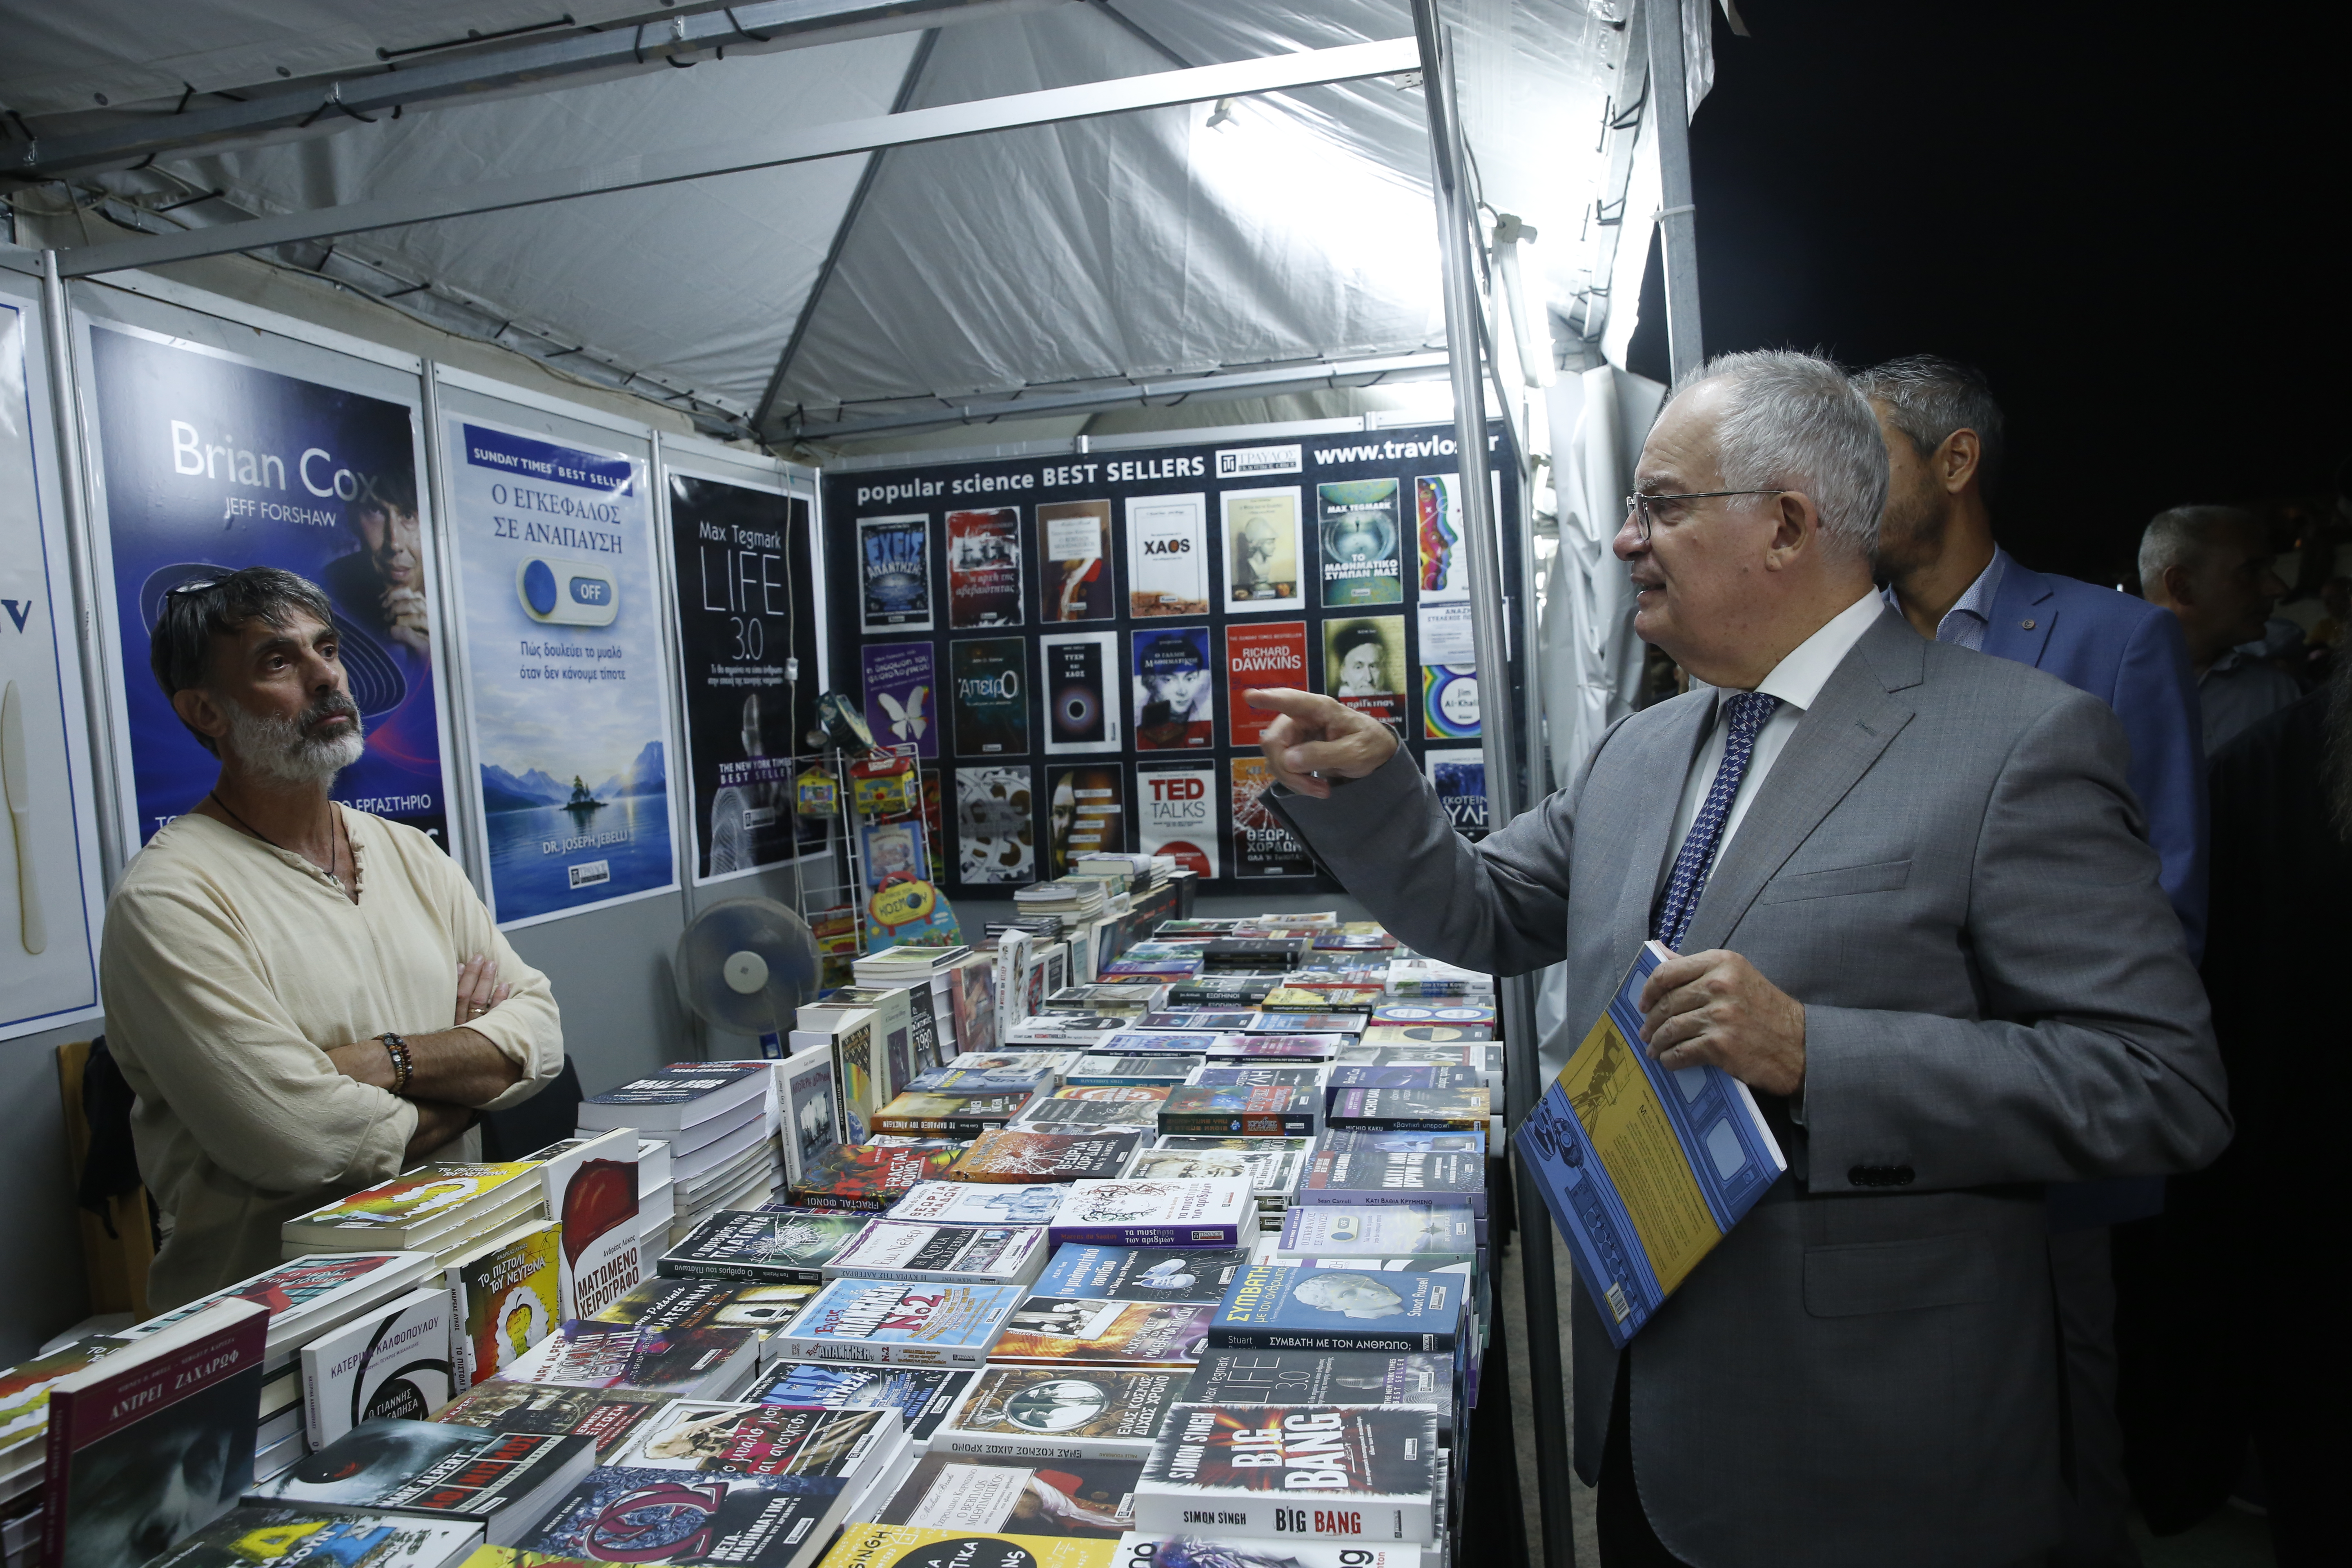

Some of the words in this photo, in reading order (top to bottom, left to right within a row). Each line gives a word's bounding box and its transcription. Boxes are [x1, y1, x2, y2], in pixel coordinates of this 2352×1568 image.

[171, 419, 286, 491] Brian
[300, 448, 378, 502] Cox
[473, 448, 518, 467] SUNDAY
[521, 458, 552, 474] TIMES
[558, 466, 586, 481] BEST
[1239, 449, 1296, 463] ΤΡΑΥΛΟΣ
[856, 475, 944, 506] popular
[952, 474, 1034, 495] science
[1042, 464, 1098, 487] BEST
[1107, 456, 1205, 482] SELLERS
[225, 496, 255, 519] JEFF
[261, 501, 337, 527] FORSHAW
[492, 483, 508, 505] Ο
[514, 488, 621, 524] ΕΓΚΕΦΑΛΟΣ
[1327, 505, 1347, 513] MAX
[1349, 501, 1392, 512] TEGMARK
[494, 516, 520, 539] ΣΕ
[524, 522, 623, 554] ΑΝΑΠΑΥΣΗ
[699, 521, 726, 542] Max
[731, 524, 782, 550] Tegmark
[1325, 559, 1398, 572] ΜΑΘΗΜΑΤΙΚΟ
[1325, 570, 1370, 580] ΣΥΜΠΑΝ
[1373, 567, 1398, 577] ΜΑΣ
[580, 584, 601, 600] OFF
[701, 546, 784, 615] LIFE
[521, 641, 541, 659] Πώς
[544, 643, 583, 657] δουλεύει
[585, 644, 595, 656] το
[597, 642, 622, 659] μυαλό
[730, 617, 764, 661] 3.0
[1242, 645, 1290, 658] RICHARD
[520, 666, 541, 679] όταν
[544, 667, 561, 680] δεν
[562, 667, 598, 683] κάνουμε
[599, 667, 626, 683] τίποτε
[1232, 655, 1302, 672] DAWKINS
[1458, 688, 1471, 698] Jim
[719, 762, 734, 773] THE
[735, 761, 752, 771] NEW
[720, 771, 749, 785] BEST
[1149, 778, 1205, 801] TED
[356, 794, 431, 813] ΕΡΓΑΣΤΗΡΙΟ
[1150, 801, 1205, 819] TALKS
[543, 841, 560, 855] DR.
[561, 837, 596, 855] JOSEPH
[597, 830, 628, 849] JEBELLI
[915, 1029, 933, 1052] 1980
[1363, 1098, 1378, 1117] MICHIO
[909, 1120, 919, 1129] ΤΟΥ
[920, 1120, 947, 1129] ΠΑΡΑΔΟΞΟ
[948, 1121, 956, 1129] ΤΟ
[1056, 1142, 1090, 1170] ΘΕΩΡΙΑ
[1071, 1140, 1106, 1171] ΧΟΡΔΩΝ
[884, 1150, 909, 1188] FRACTAL
[900, 1159, 921, 1187] ΦΟΝΟΙ
[807, 1197, 837, 1207] ΦΟΝΟΙ
[840, 1198, 879, 1209] FRACTAL
[909, 1186, 948, 1216] ΘΕΩΡΙΑ
[922, 1186, 962, 1217] ΟΜΑΔΩΝ
[1302, 1212, 1316, 1241] ΕΓΚΕΦΑΛΟΣ
[1317, 1212, 1329, 1238] ΑΝΑΠΑΥΣΗ
[497, 1249, 514, 1261] ΑΝΔΡΕΑΣ
[514, 1243, 528, 1254] ΛΥΚΟΣ
[603, 1246, 622, 1258] Ανδρέας
[622, 1235, 636, 1250] Λύκος
[941, 1228, 972, 1256] ΑΛΓΕΒΡΑΣ
[477, 1272, 491, 1288] ΤΟ
[492, 1253, 525, 1278] ΠΙΣΤΟΛΙ
[490, 1277, 506, 1294] ΤΟΥ
[506, 1256, 546, 1287] ΝΕΥΤΩΝΑ
[577, 1246, 638, 1300] ΜΑΤΩΜΕΝΟ
[674, 1264, 704, 1274] Πλάτωνα
[717, 1267, 746, 1276] αριθμός
[1064, 1247, 1100, 1288] μαθηματικό
[579, 1266, 640, 1321] ΧΕΙΡΟΓΡΑΦΟ
[1225, 1266, 1273, 1322] ΣΥΜΒΑΤΗ
[1262, 1266, 1290, 1300] άνθρωπο;
[650, 1285, 686, 1316] Petsinis
[1259, 1298, 1271, 1310] τον
[1406, 1298, 1421, 1317] Stuart
[1415, 1277, 1430, 1297] Russell
[1254, 1310, 1269, 1323] με
[331, 1346, 374, 1379] ΚΑΤΕΡΙΝΑ
[376, 1316, 439, 1355] ΚΑΛΦΟΠΟΥΛΟΥ
[455, 1346, 463, 1356] ΤΟ
[818, 1344, 875, 1361] ΑΠΑΝΤΗΣΗ;
[1228, 1335, 1253, 1345] Stuart
[1270, 1336, 1314, 1347] ΣΥΜΒΑΤΗ
[1316, 1339, 1330, 1348] ΜΕ
[1332, 1339, 1352, 1348] ΤΟΝ
[1356, 1341, 1412, 1351] ΑΝΘΡΩΠΟ;
[457, 1358, 466, 1385] ΠΙΣΤΟΛΙ
[532, 1364, 554, 1383] MARK
[545, 1334, 567, 1362] ALPERT
[1207, 1356, 1231, 1384] Tegmark
[1395, 1358, 1405, 1383] SELLER
[109, 1383, 163, 1421] ΑΝΤΡΕΙ
[175, 1350, 240, 1390] ΖΑΧΑΡΩΦ
[1219, 1356, 1281, 1404] LIFE
[1275, 1370, 1311, 1390] 3.0
[377, 1388, 412, 1414] ΓΙΑΝΝΗΣ
[449, 1396, 476, 1416] ALPERT
[1116, 1411, 1137, 1435] ΕΝΑΣ
[1128, 1376, 1154, 1411] ΚΟΣΜΟΣ
[1133, 1407, 1158, 1436] ΔΙΧΩΣ
[1146, 1375, 1171, 1406] ΧΡΟΝΟ
[1200, 1386, 1217, 1403] Max
[731, 1425, 764, 1464] μυαλό
[757, 1405, 782, 1428] μου
[1183, 1412, 1217, 1443] SINGH
[951, 1442, 983, 1453] ΧΡΟΝΟ
[985, 1444, 1012, 1455] ΔΙΧΩΣ
[1014, 1446, 1055, 1457] ΚΟΣΜΟΣ
[1057, 1448, 1082, 1459] ΕΝΑΣ
[1231, 1428, 1285, 1468] BIG
[1285, 1412, 1349, 1489] BANG
[1168, 1446, 1205, 1480] SIMON
[381, 1483, 422, 1508] MARK
[421, 1453, 472, 1487] ALPERT
[724, 1497, 790, 1562] ΜΑΘΗΜΑΤΙΚΑ
[1183, 1510, 1215, 1524] SIMON
[1218, 1510, 1247, 1526] SINGH
[1276, 1506, 1307, 1533] BIG
[1314, 1510, 1362, 1535] BANG
[707, 1530, 742, 1559] ΜΕΤΑ-
